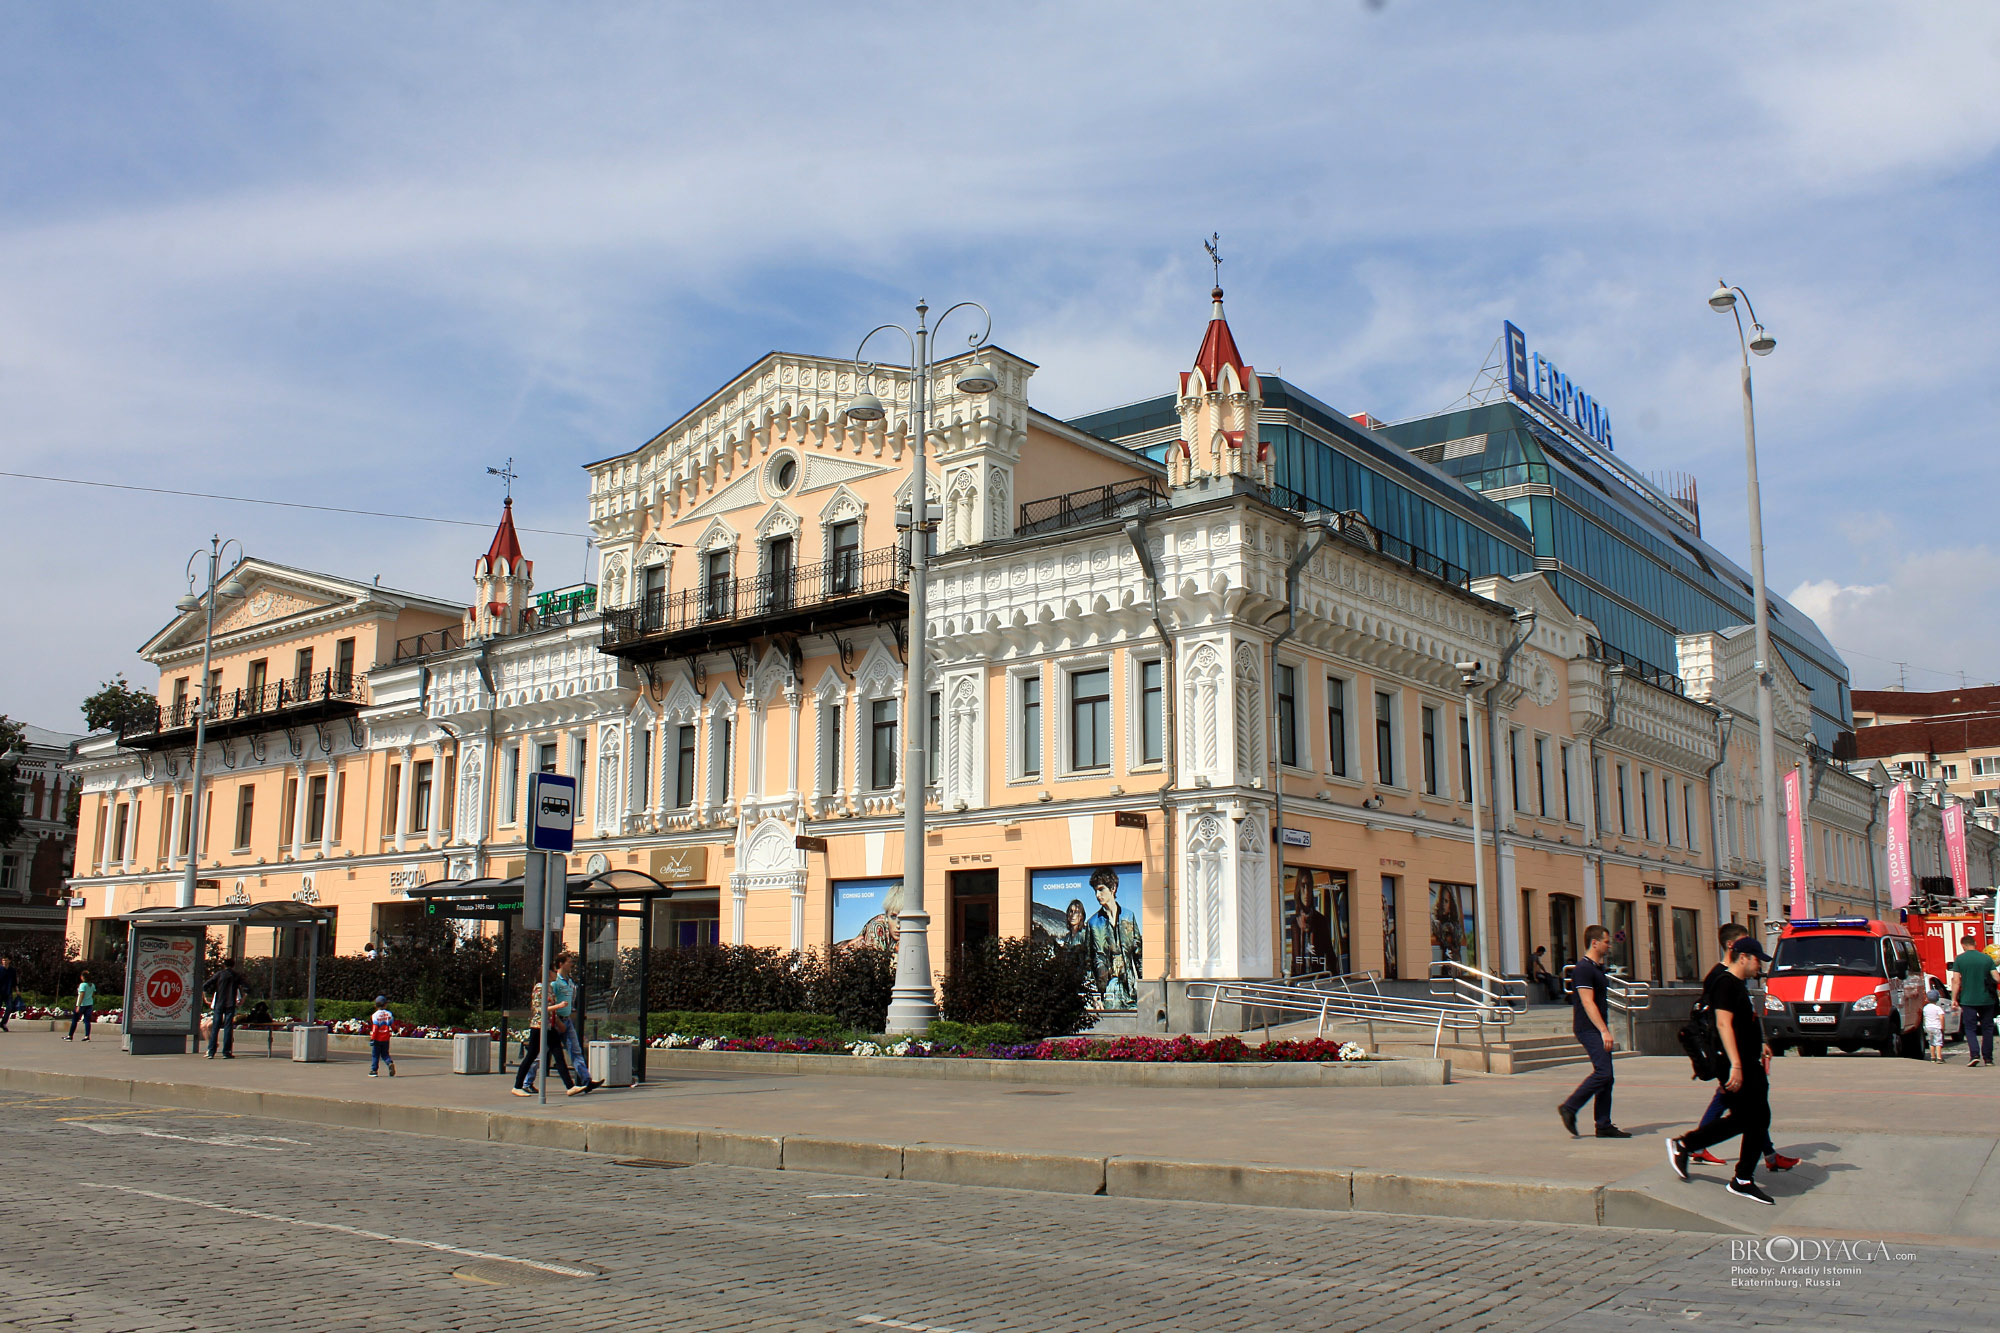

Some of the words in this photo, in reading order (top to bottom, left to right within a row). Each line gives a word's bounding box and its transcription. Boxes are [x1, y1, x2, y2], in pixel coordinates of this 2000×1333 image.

[1533, 351, 1614, 451] ЕВРОПА
[950, 854, 992, 864] ETRO
[390, 869, 427, 887] ЕВРОПА
[225, 893, 251, 905] OMEGA
[292, 889, 320, 902] OMEGA
[1927, 927, 1943, 938] АЦ
[1967, 927, 1976, 936] 3
[1296, 956, 1326, 965] ETRO
[150, 981, 180, 998] 70%
